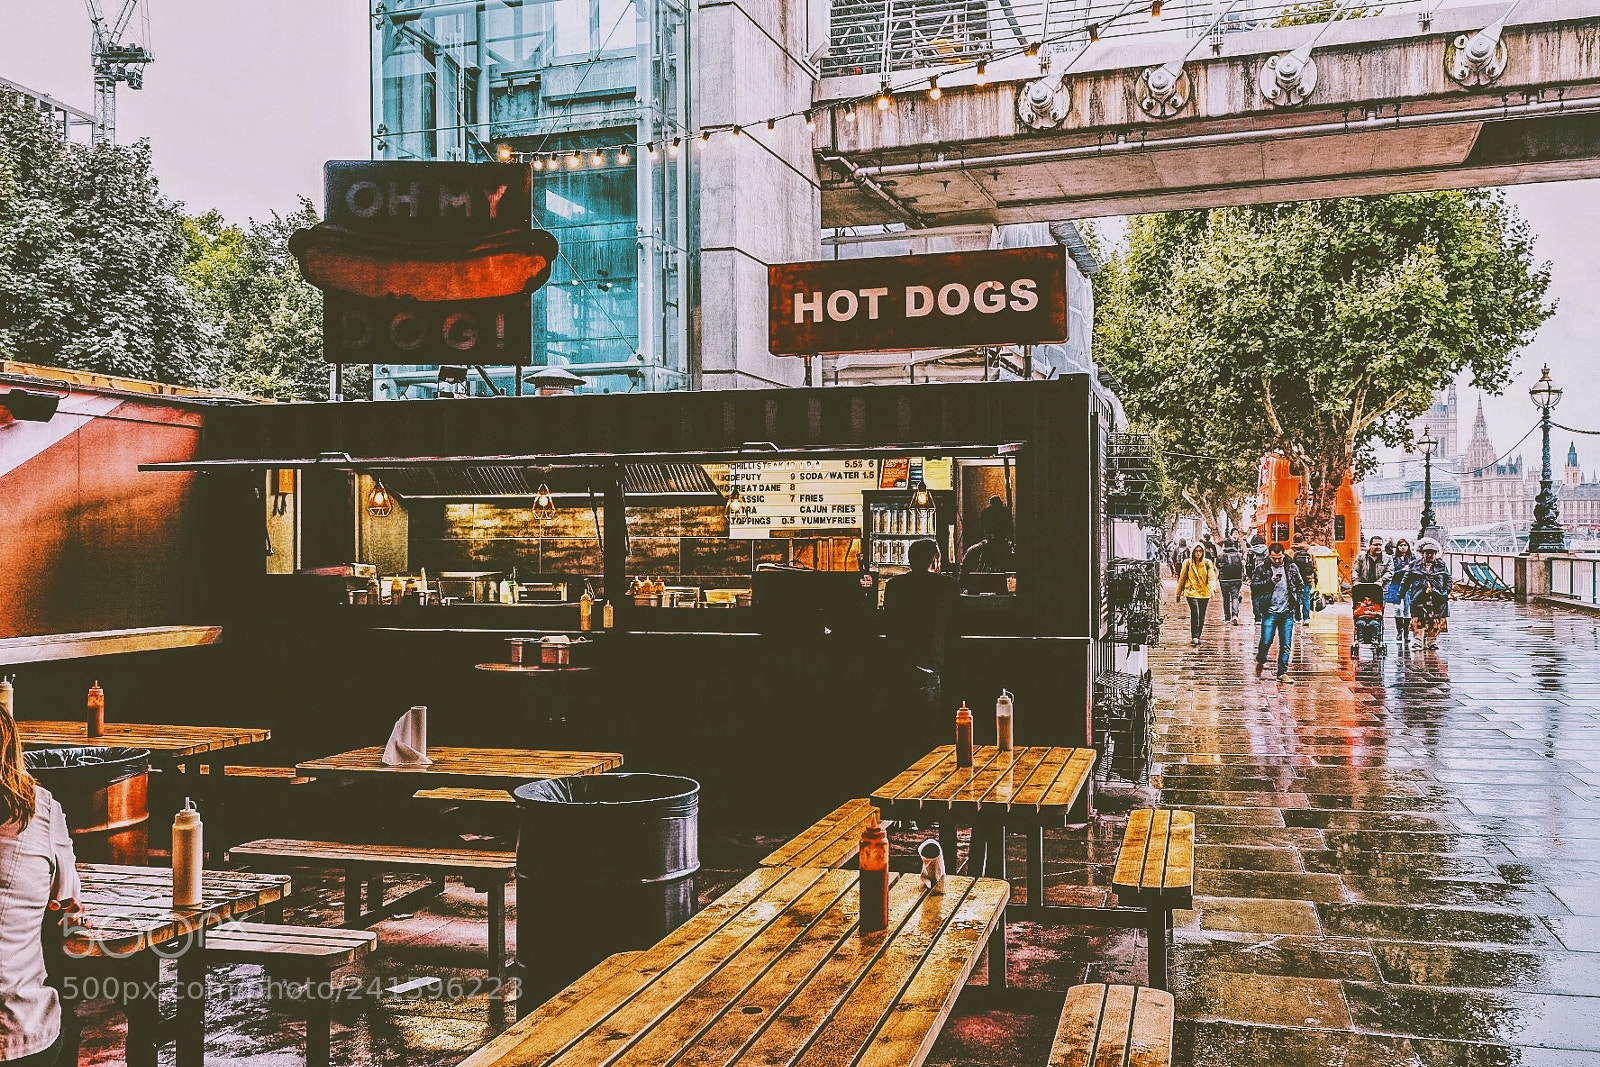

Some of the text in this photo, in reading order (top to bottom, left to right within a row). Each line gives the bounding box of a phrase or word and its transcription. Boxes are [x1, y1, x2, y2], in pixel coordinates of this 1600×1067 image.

[346, 181, 508, 219] OH MY
[793, 278, 1039, 324] HOT DOGS
[342, 310, 505, 351] DOG!
[868, 460, 875, 468] 6
[730, 473, 762, 481] DEPUTY
[790, 472, 796, 480] 9
[800, 471, 859, 480] SODA/WATER
[862, 471, 875, 479] 1.5
[759, 484, 781, 492] DANE
[731, 495, 765, 503] ASSIC
[800, 494, 824, 502] FRIES
[800, 504, 856, 513] CAJUN FRIES
[731, 517, 796, 525] TOPPINGS 0.5
